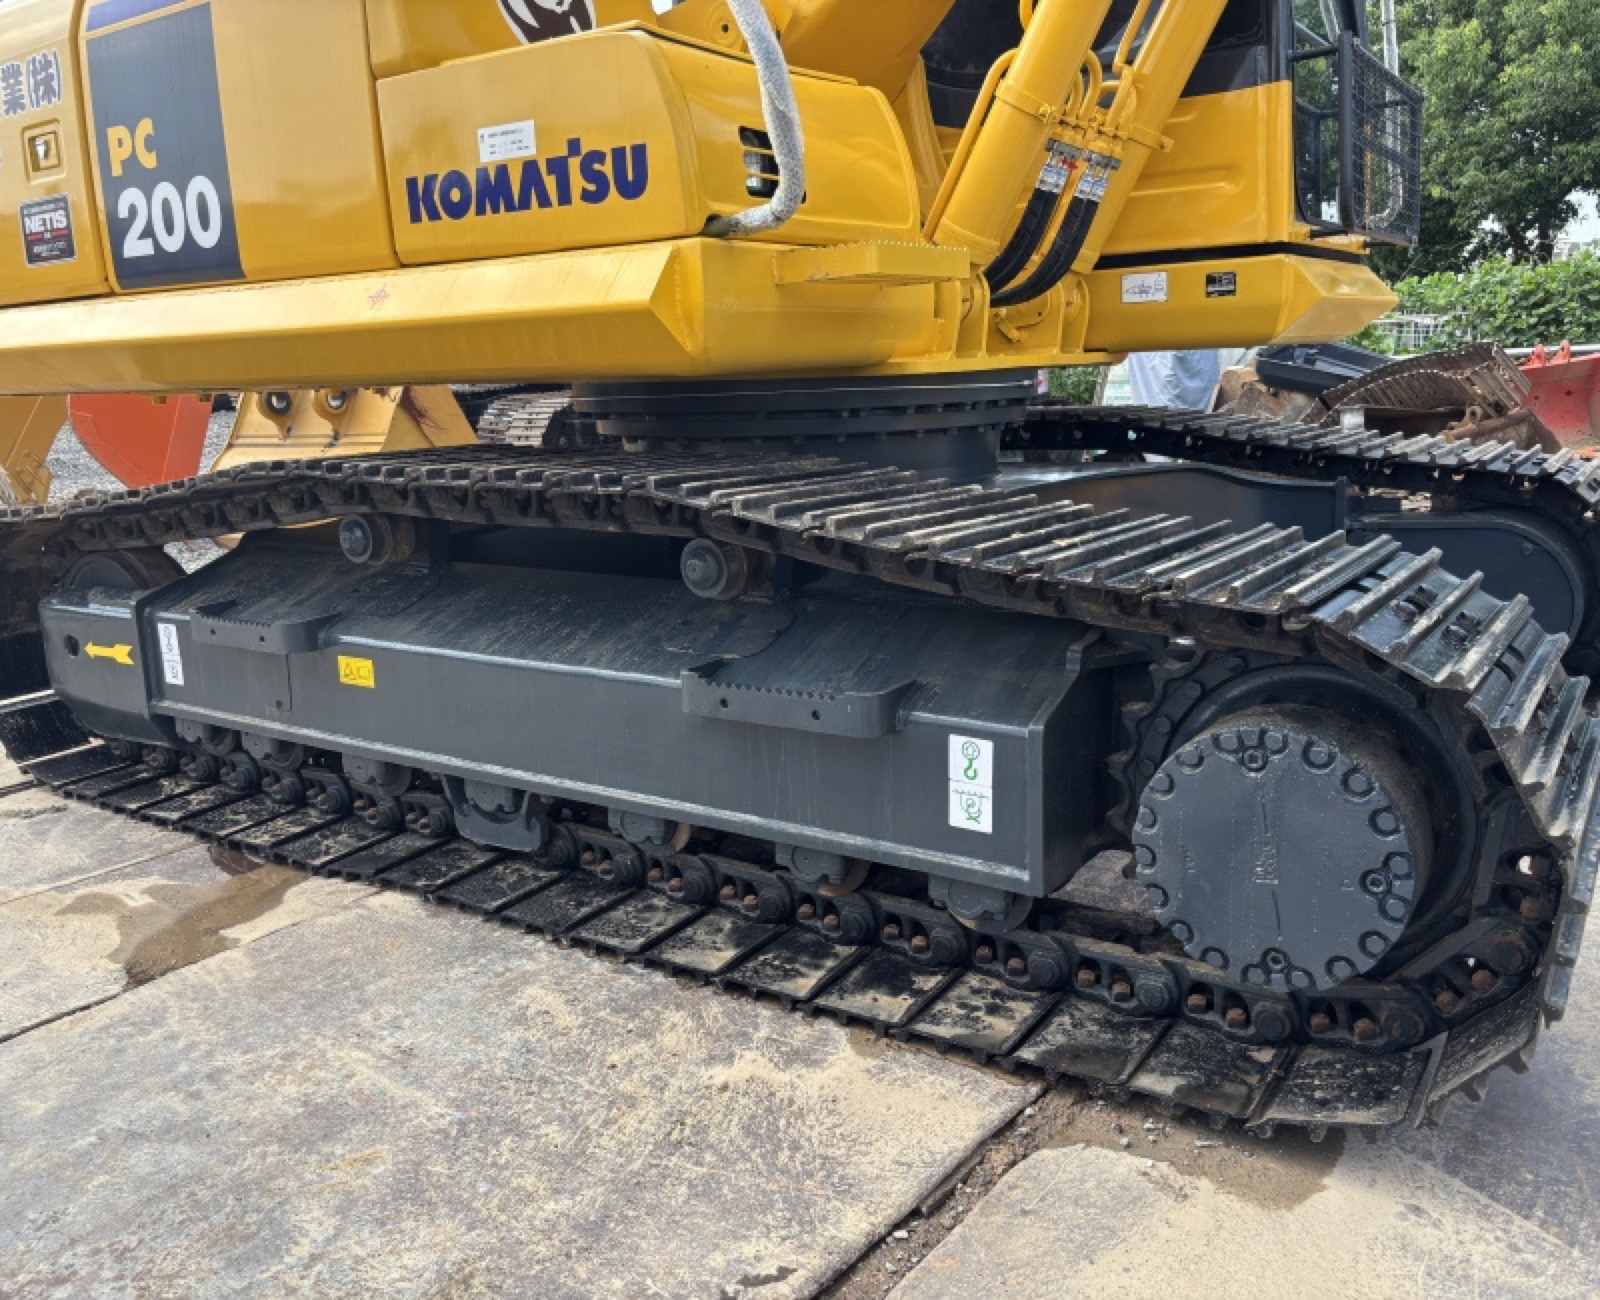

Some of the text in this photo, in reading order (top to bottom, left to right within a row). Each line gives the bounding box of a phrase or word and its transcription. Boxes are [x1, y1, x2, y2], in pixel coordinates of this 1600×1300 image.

[106, 118, 157, 176] PC
[405, 138, 645, 224] KOMATSU
[24, 210, 67, 234] NETIS
[117, 175, 222, 258] 200
